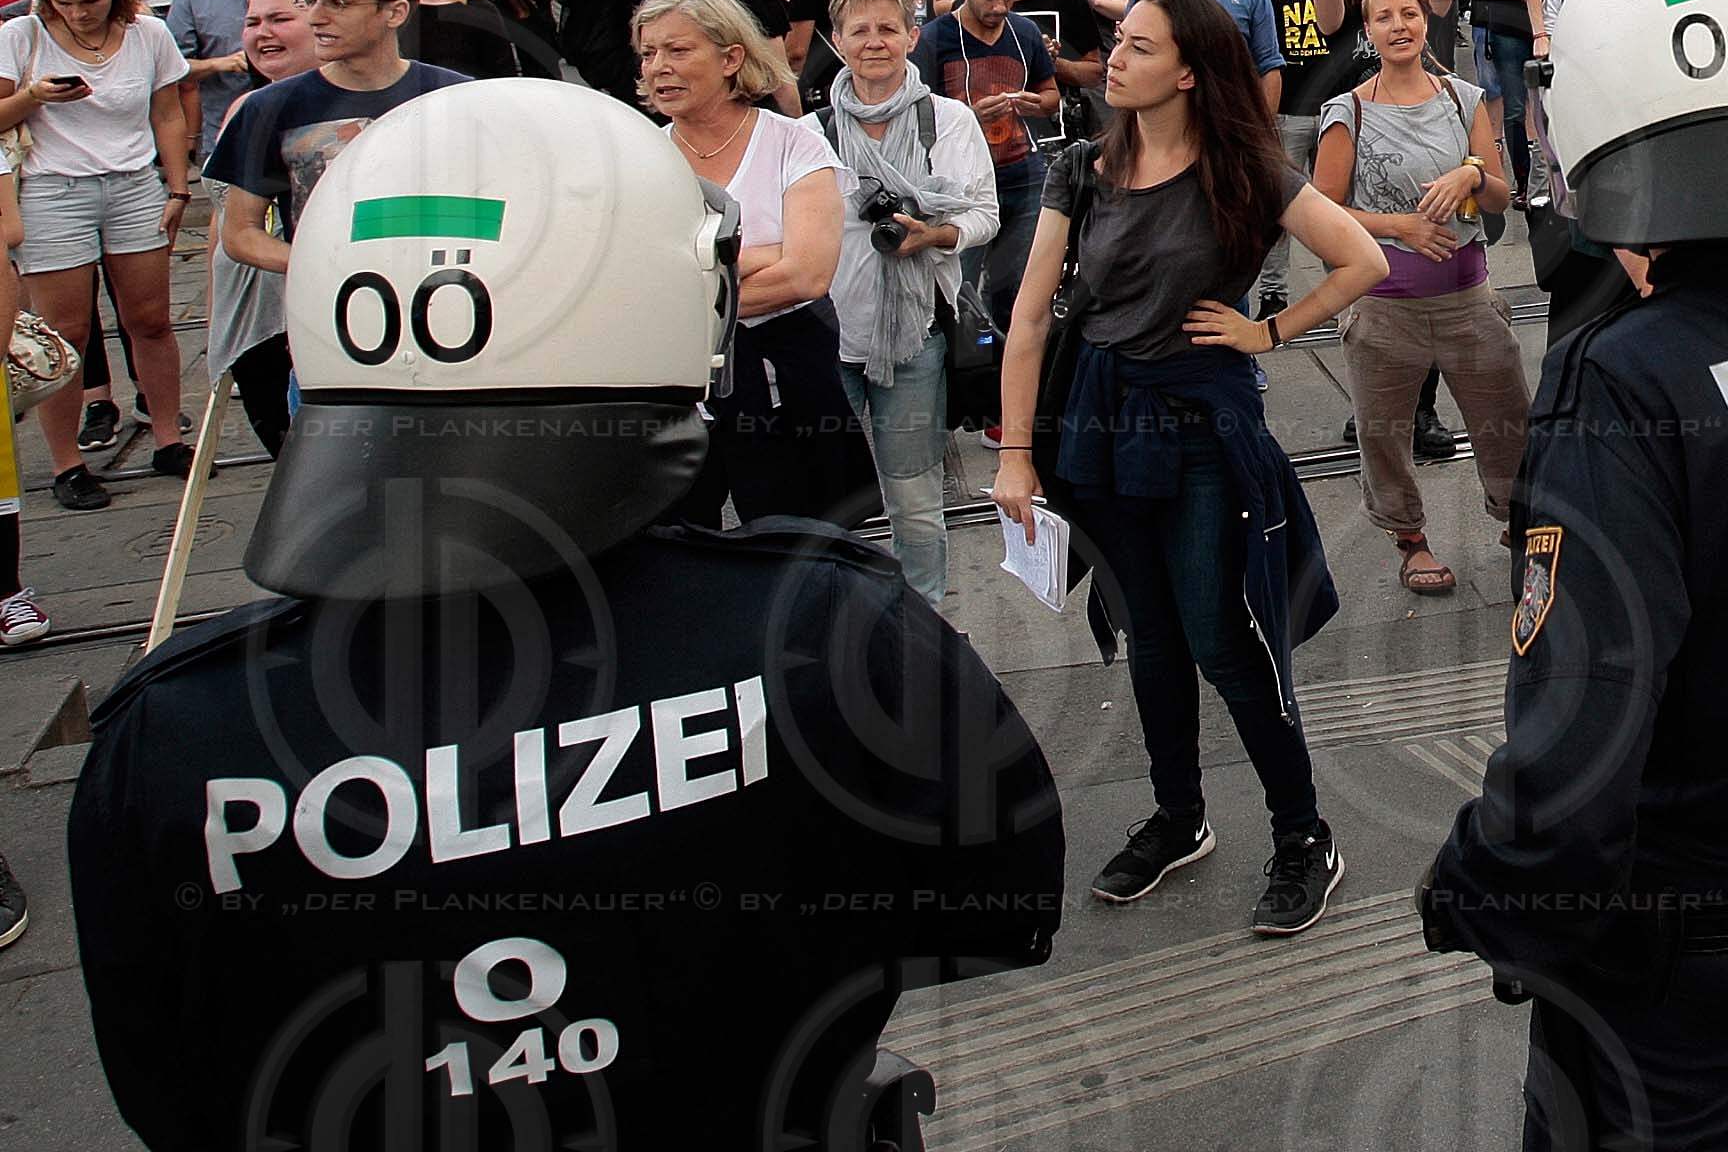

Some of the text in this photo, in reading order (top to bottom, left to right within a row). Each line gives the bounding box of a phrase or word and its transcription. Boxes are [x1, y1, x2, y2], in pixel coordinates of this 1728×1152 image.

[1283, 0, 1318, 27] NA
[204, 676, 769, 894] POLIZEI
[425, 1018, 620, 1097] 140
